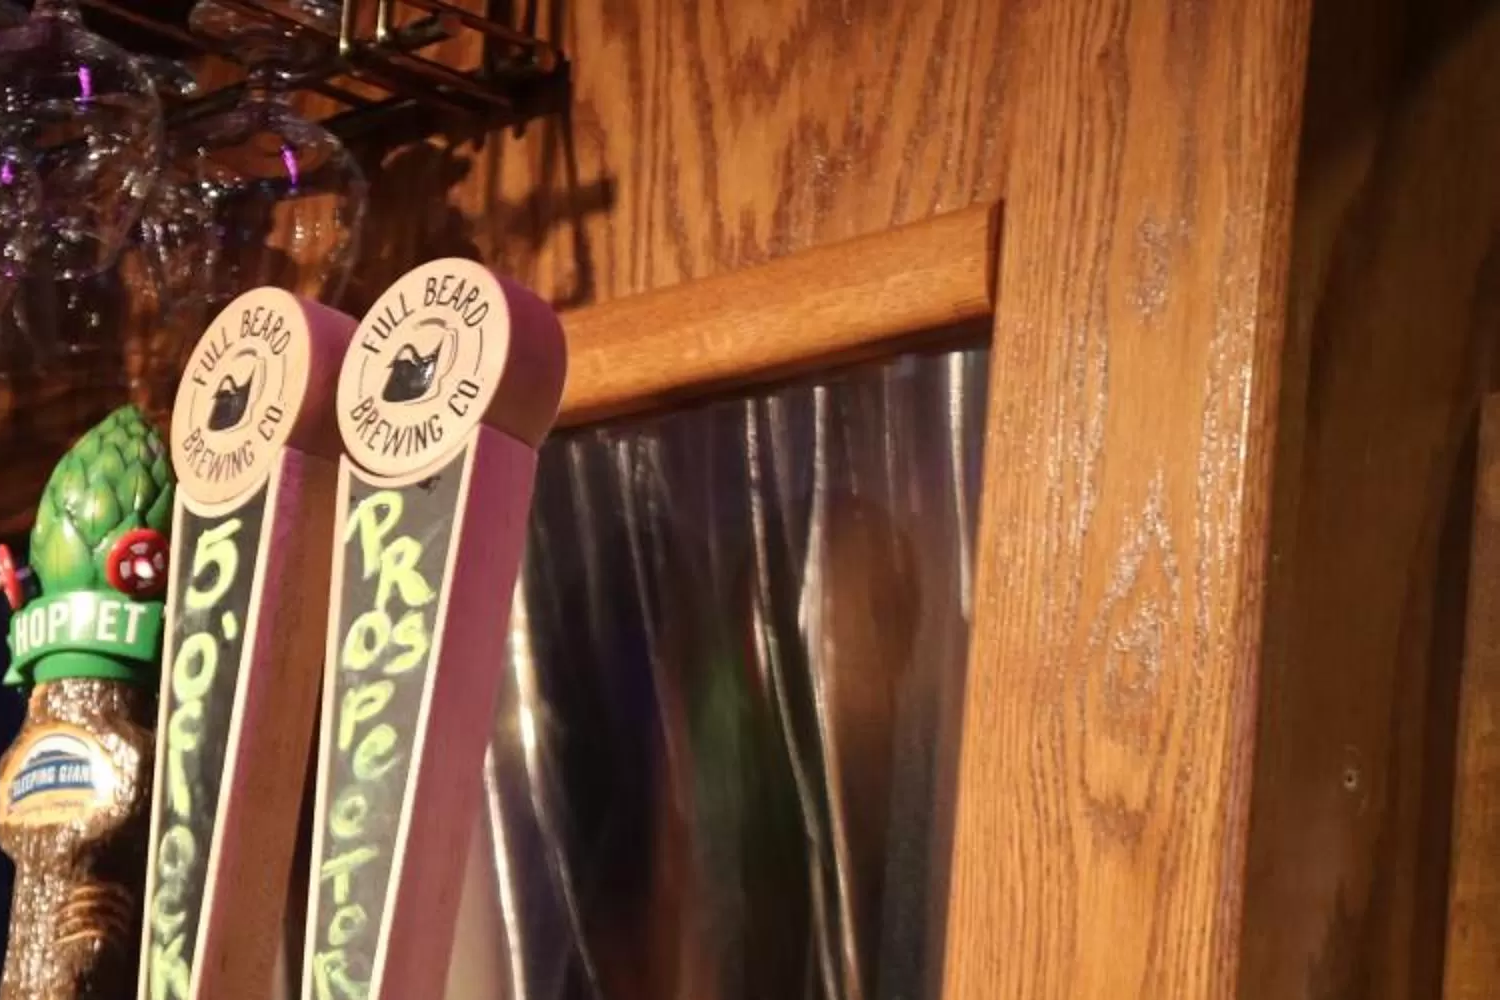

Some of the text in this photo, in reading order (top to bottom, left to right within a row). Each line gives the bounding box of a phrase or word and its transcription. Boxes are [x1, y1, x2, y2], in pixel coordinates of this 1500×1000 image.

[362, 275, 489, 354] FULL BEARD
[192, 306, 291, 387] FULL BEARD
[182, 427, 255, 482] BREWING
[349, 396, 443, 457] BREWING
[15, 600, 147, 656] HOPET
[58, 764, 92, 784] GIAN
